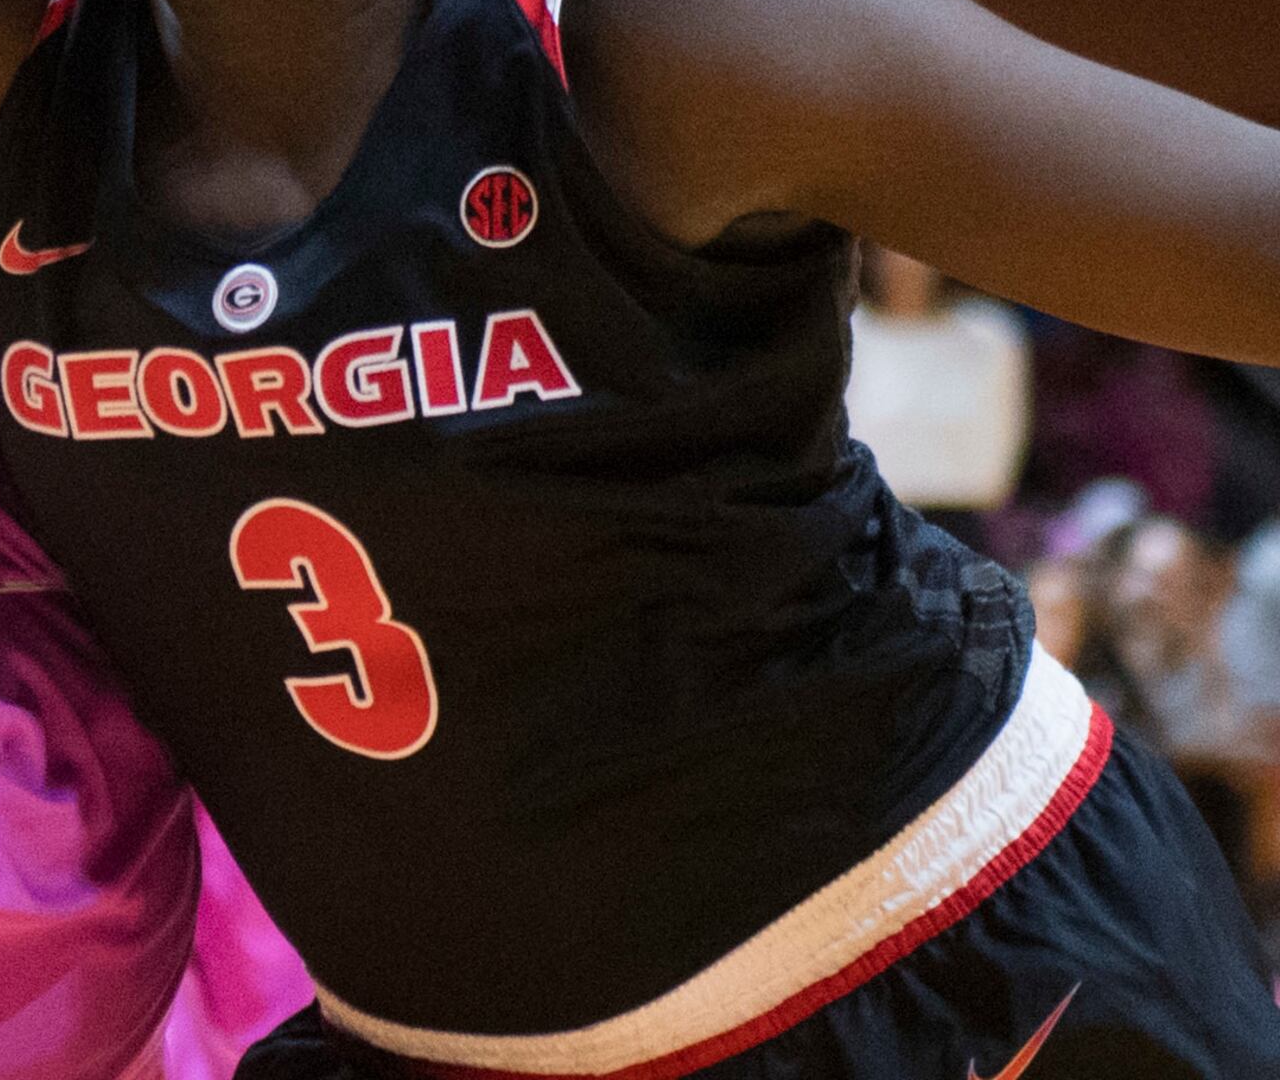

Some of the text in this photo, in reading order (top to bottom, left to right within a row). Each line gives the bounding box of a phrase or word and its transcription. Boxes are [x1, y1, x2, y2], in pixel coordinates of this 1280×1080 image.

[469, 172, 530, 241] SEC
[1, 309, 582, 440] GEORGIA
[230, 498, 438, 760] 3
